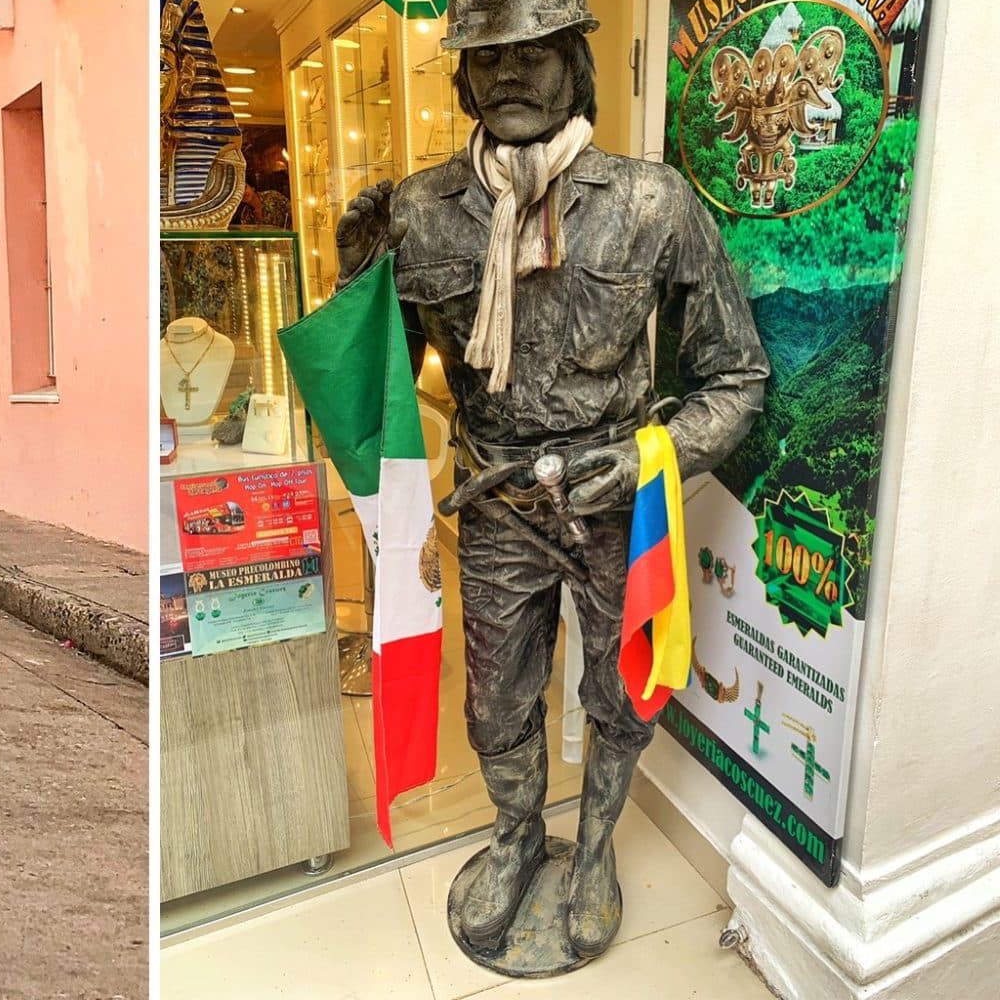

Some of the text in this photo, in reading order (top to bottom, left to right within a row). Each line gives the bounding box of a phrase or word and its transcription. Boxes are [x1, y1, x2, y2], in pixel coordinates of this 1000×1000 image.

[209, 569, 237, 580] MUSEO
[239, 558, 301, 576] PRECOLOMBINO
[209, 567, 303, 590] LA ESMERALDA
[764, 530, 838, 602] 100%
[726, 610, 846, 702] ESMERALDAS GARANTIZADAS
[733, 633, 833, 714] GUARANTEED EMERALDS
